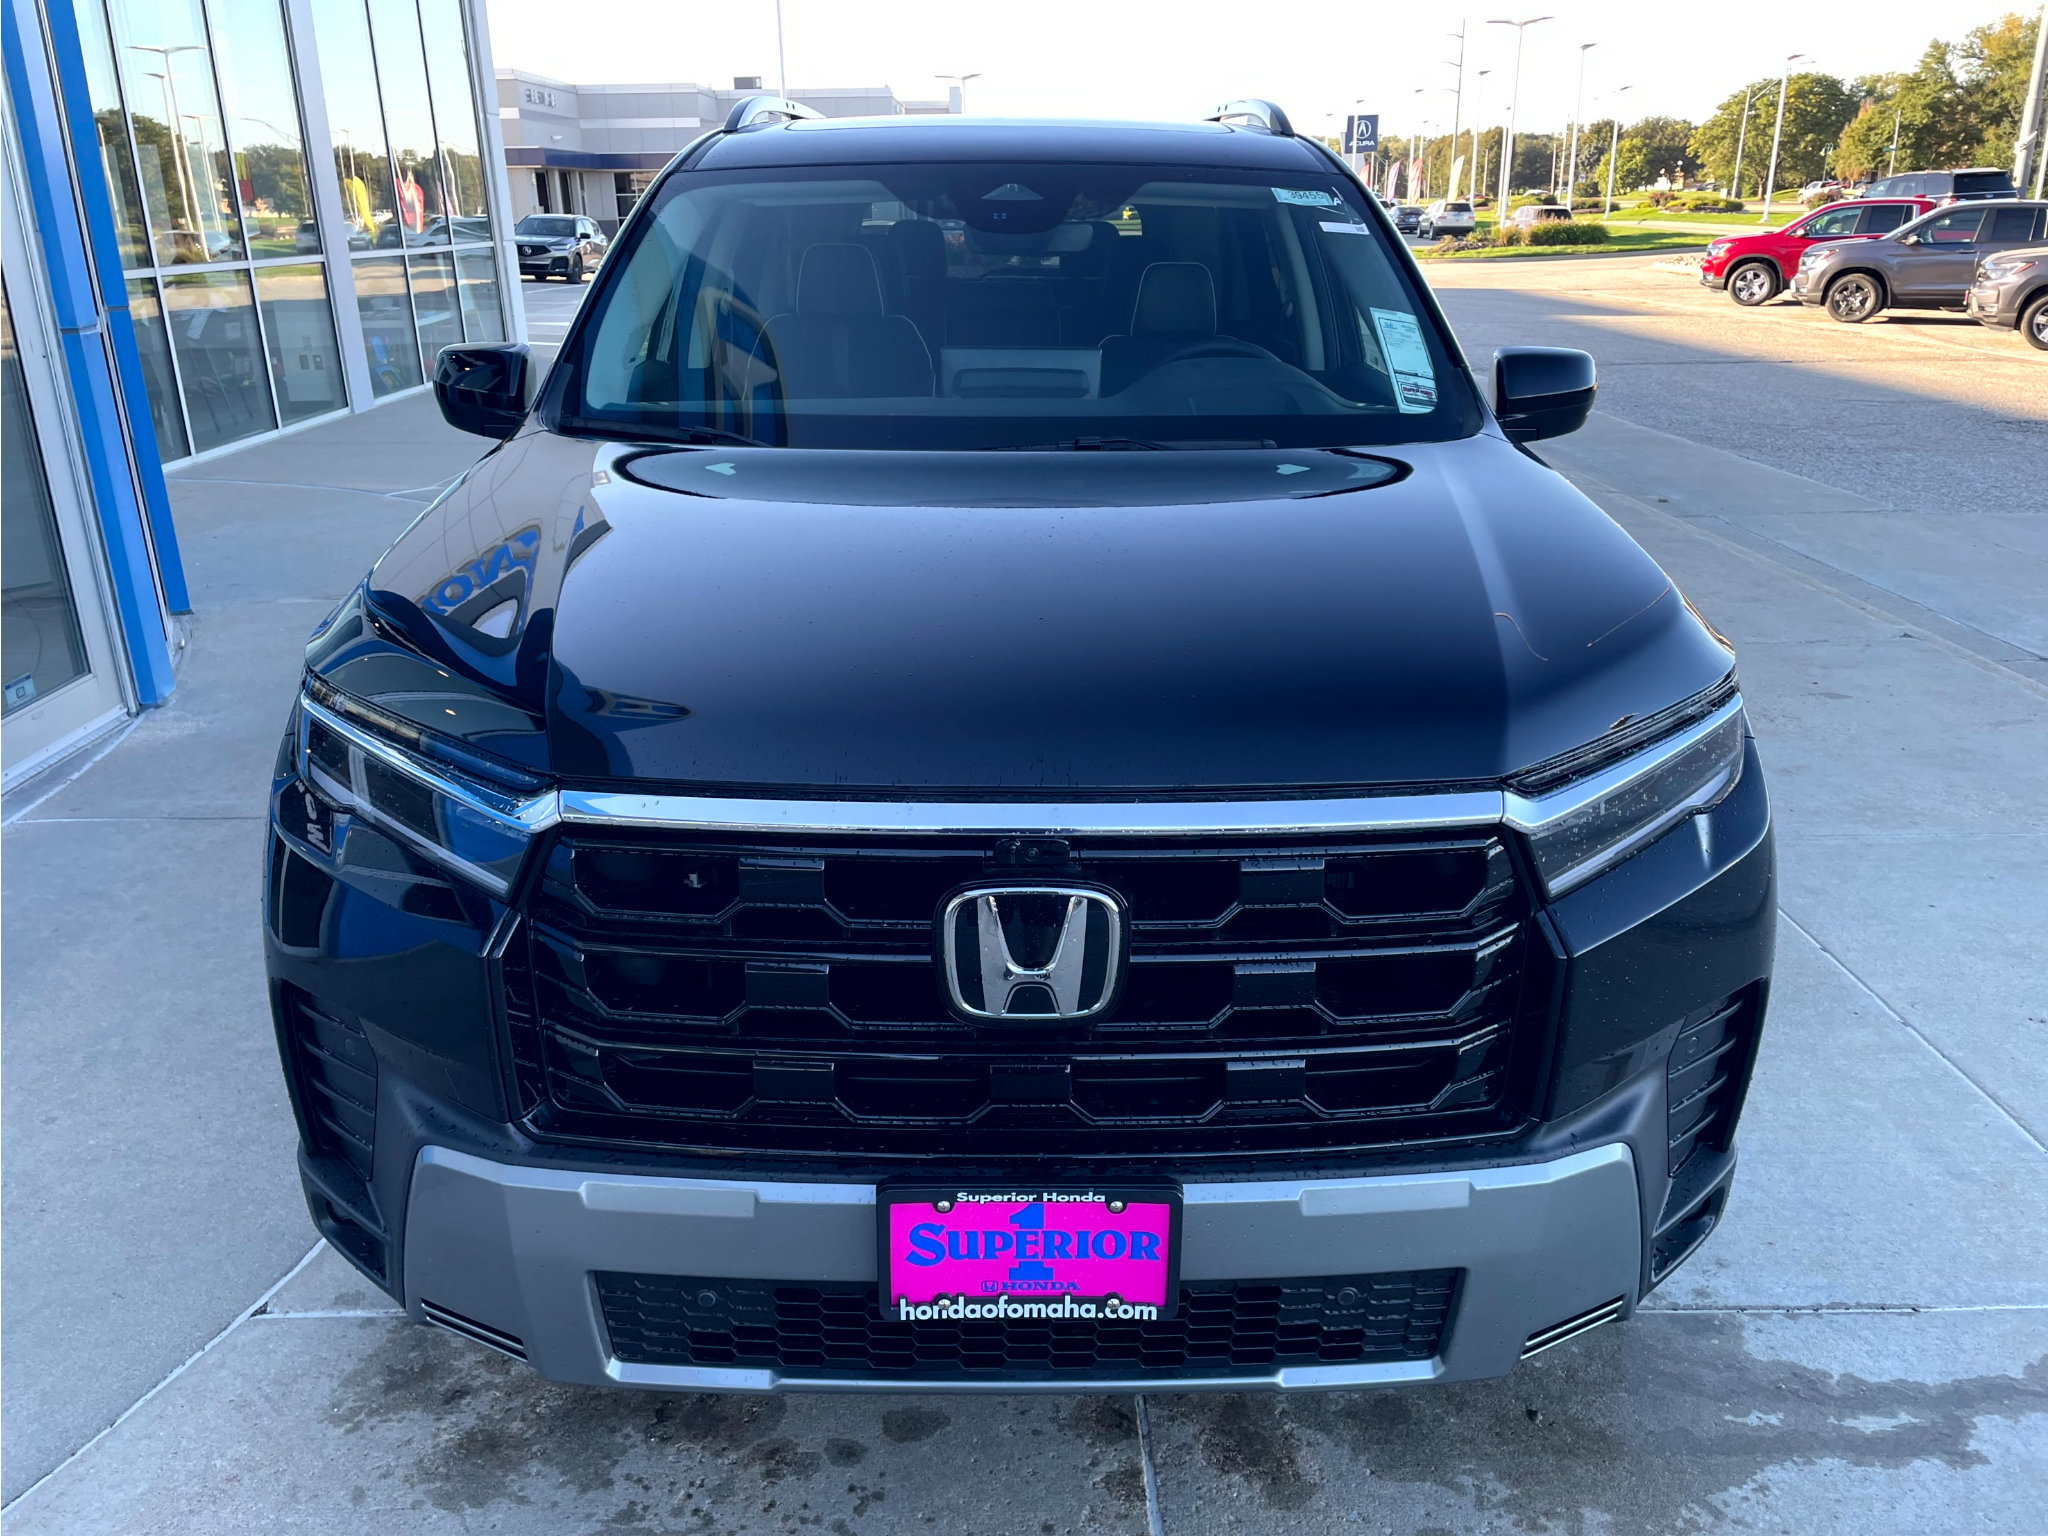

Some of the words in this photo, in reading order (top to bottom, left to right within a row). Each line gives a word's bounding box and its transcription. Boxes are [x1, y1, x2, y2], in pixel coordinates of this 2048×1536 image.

[956, 1192, 1037, 1204] Superior
[1043, 1192, 1106, 1203] Honda
[905, 1222, 1161, 1267] SUPERIOR
[1002, 1281, 1081, 1291] HONDA
[900, 1296, 1157, 1321] hondaofomaha.com
